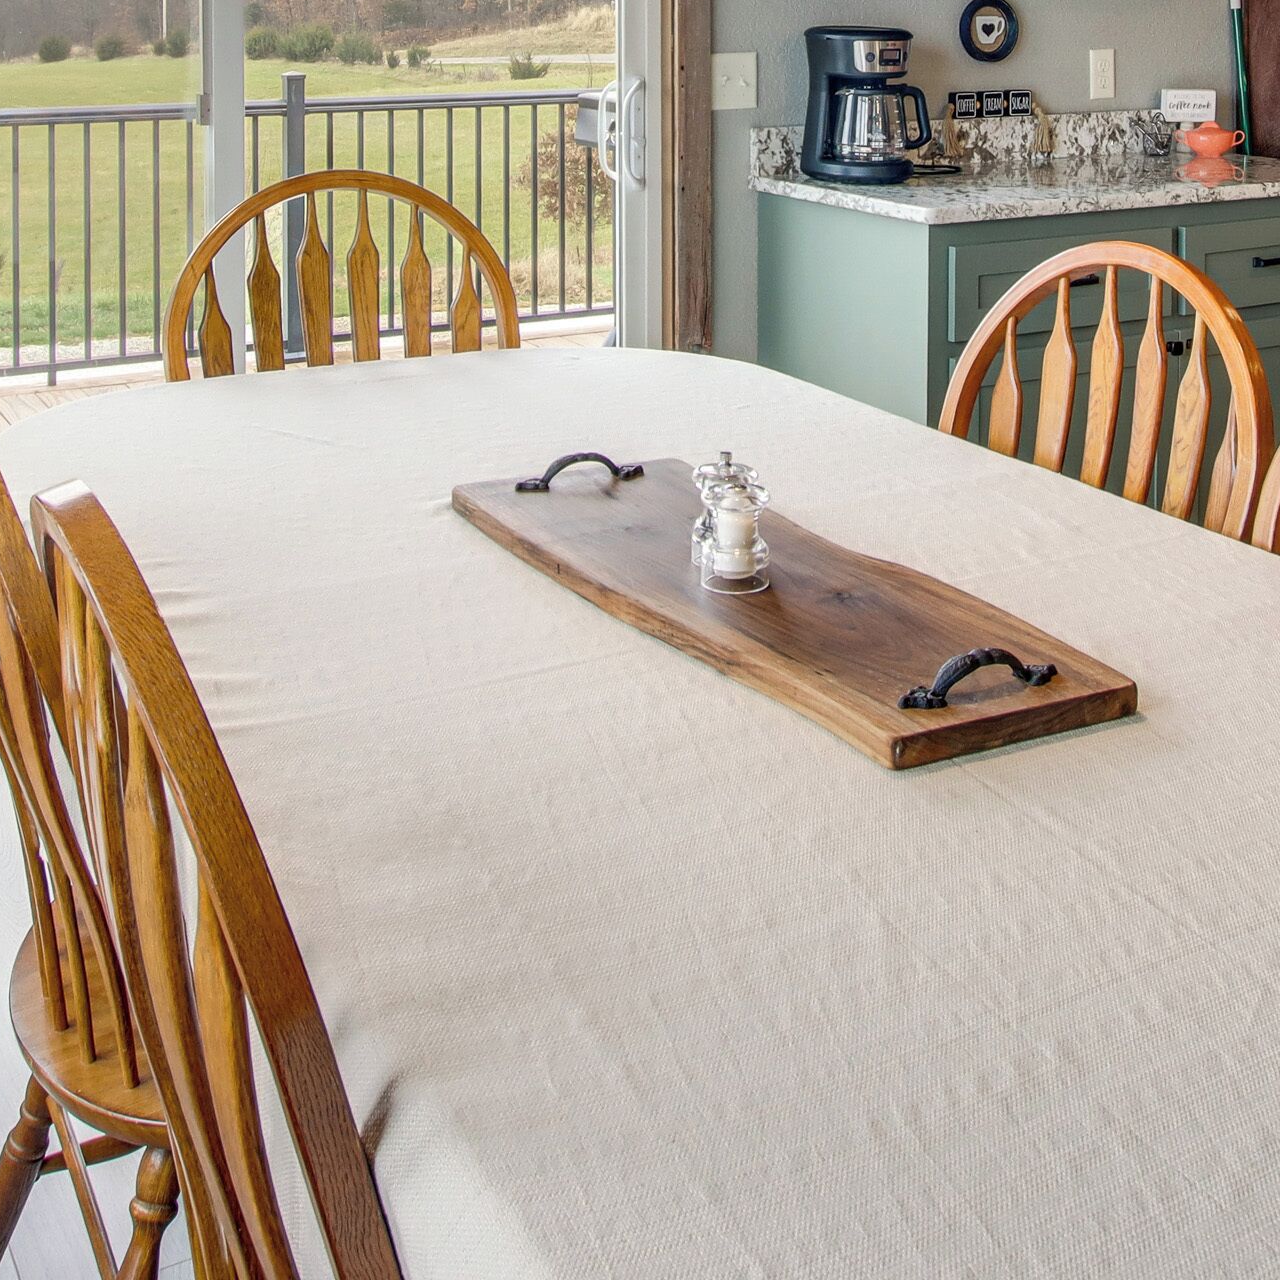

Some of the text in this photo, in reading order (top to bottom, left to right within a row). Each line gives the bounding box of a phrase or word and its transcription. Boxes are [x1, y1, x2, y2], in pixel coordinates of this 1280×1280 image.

[957, 96, 1030, 113] COFFEE CREAM SUGAR
